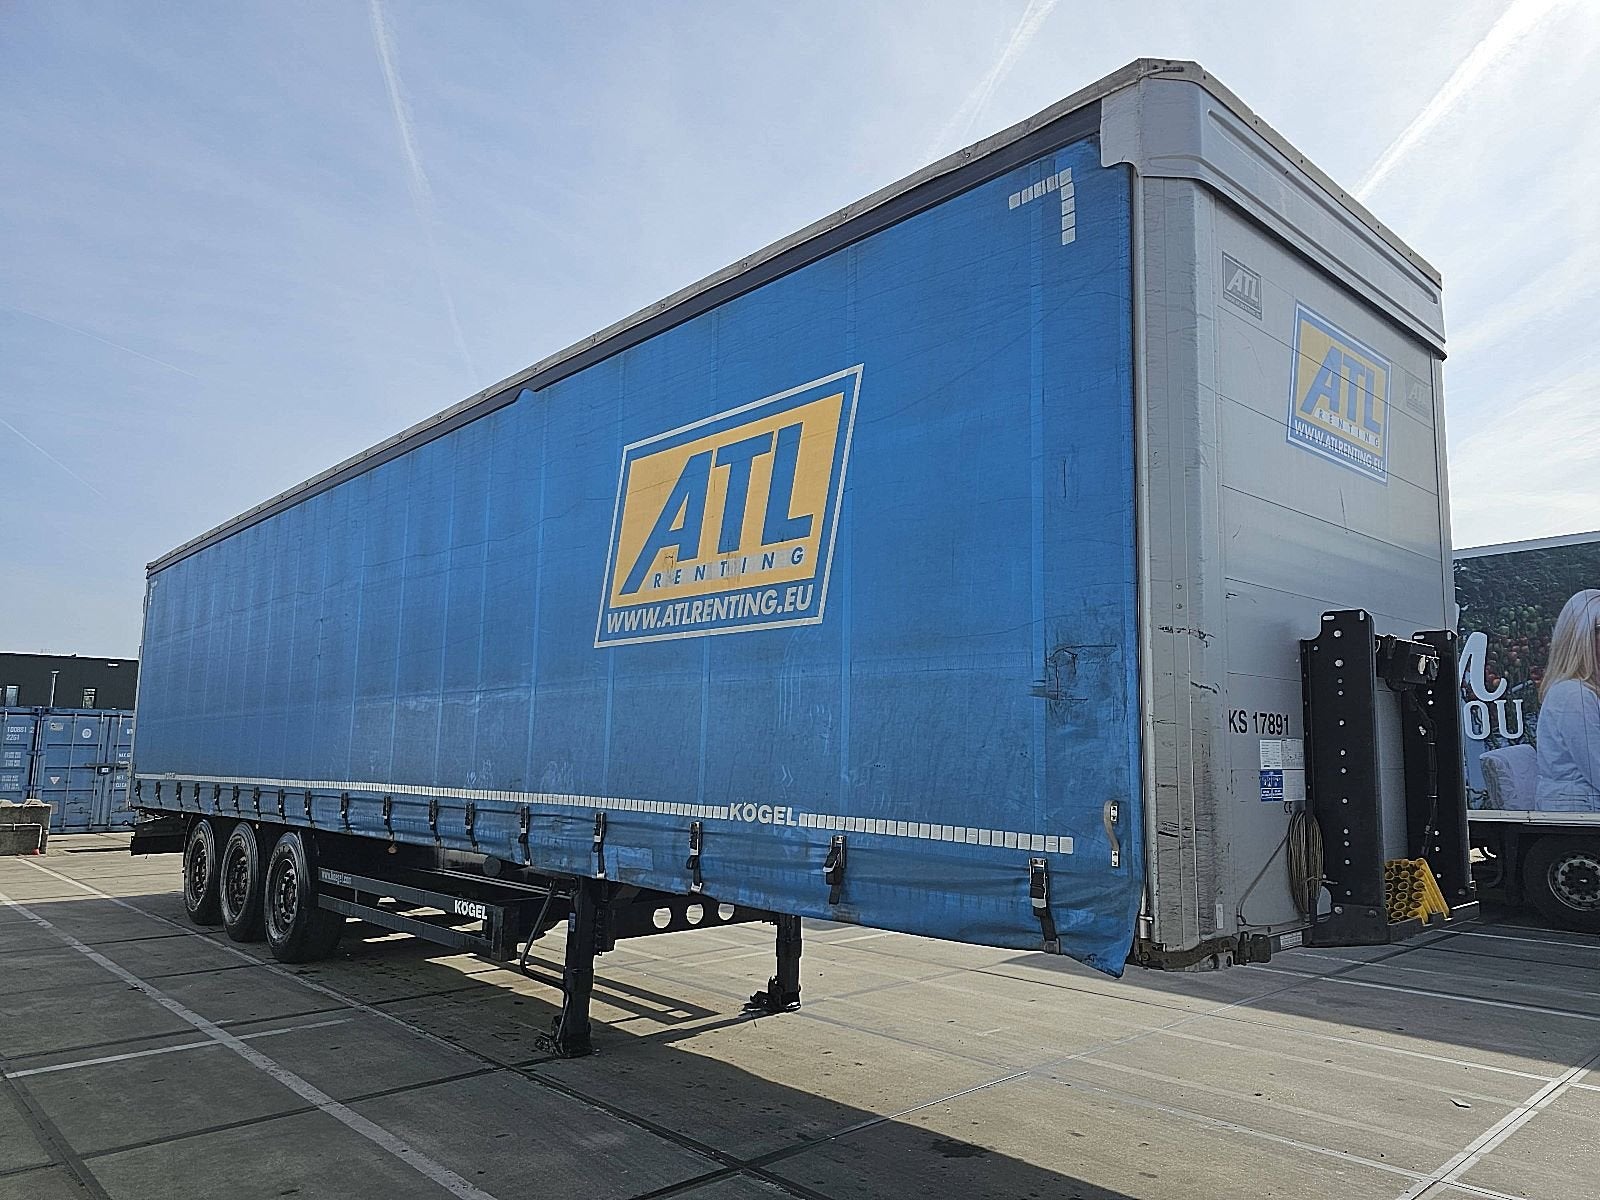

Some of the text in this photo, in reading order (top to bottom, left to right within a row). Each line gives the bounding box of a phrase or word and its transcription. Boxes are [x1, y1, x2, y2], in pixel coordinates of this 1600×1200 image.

[1227, 269, 1259, 303] ATL
[1301, 345, 1381, 435] ATL
[1294, 419, 1384, 473] WWW.ATLRENTING.EU
[1319, 408, 1379, 447] RENTING
[619, 422, 813, 596] ATL
[653, 547, 804, 588] RENTING
[607, 584, 814, 633] WWW.ATLRENTING.EU
[1228, 709, 1289, 736] KS 17891
[1463, 699, 1524, 740] OU
[729, 802, 797, 826] KÖGEL
[454, 899, 488, 920] KÖGEL
